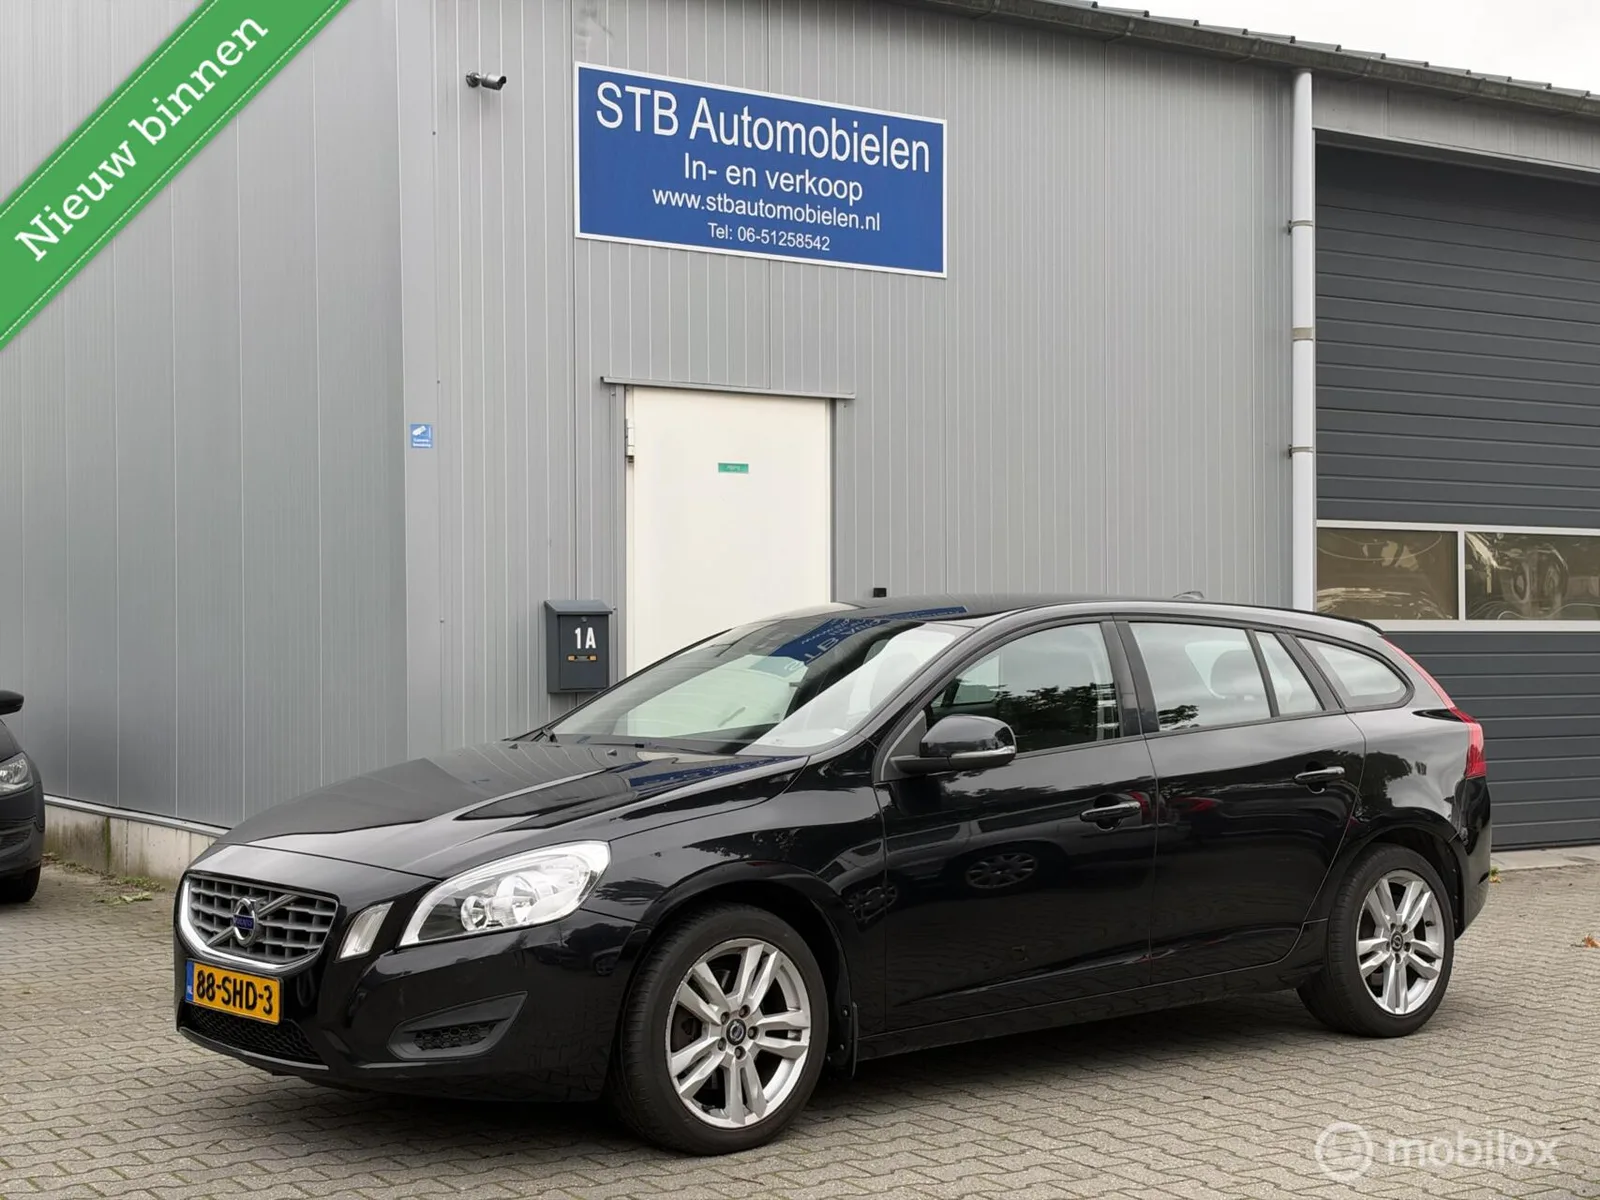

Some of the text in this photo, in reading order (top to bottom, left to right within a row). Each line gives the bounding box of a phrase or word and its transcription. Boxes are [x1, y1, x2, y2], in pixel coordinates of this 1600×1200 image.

[596, 81, 931, 173] STB Automobielen
[684, 152, 864, 206] In- en verkoop
[652, 188, 881, 232] www.stbautomobielen.nl
[708, 222, 831, 251] Tel: 06-51258542
[574, 626, 597, 650] 1A
[196, 969, 274, 1016] 88-SHD-3
